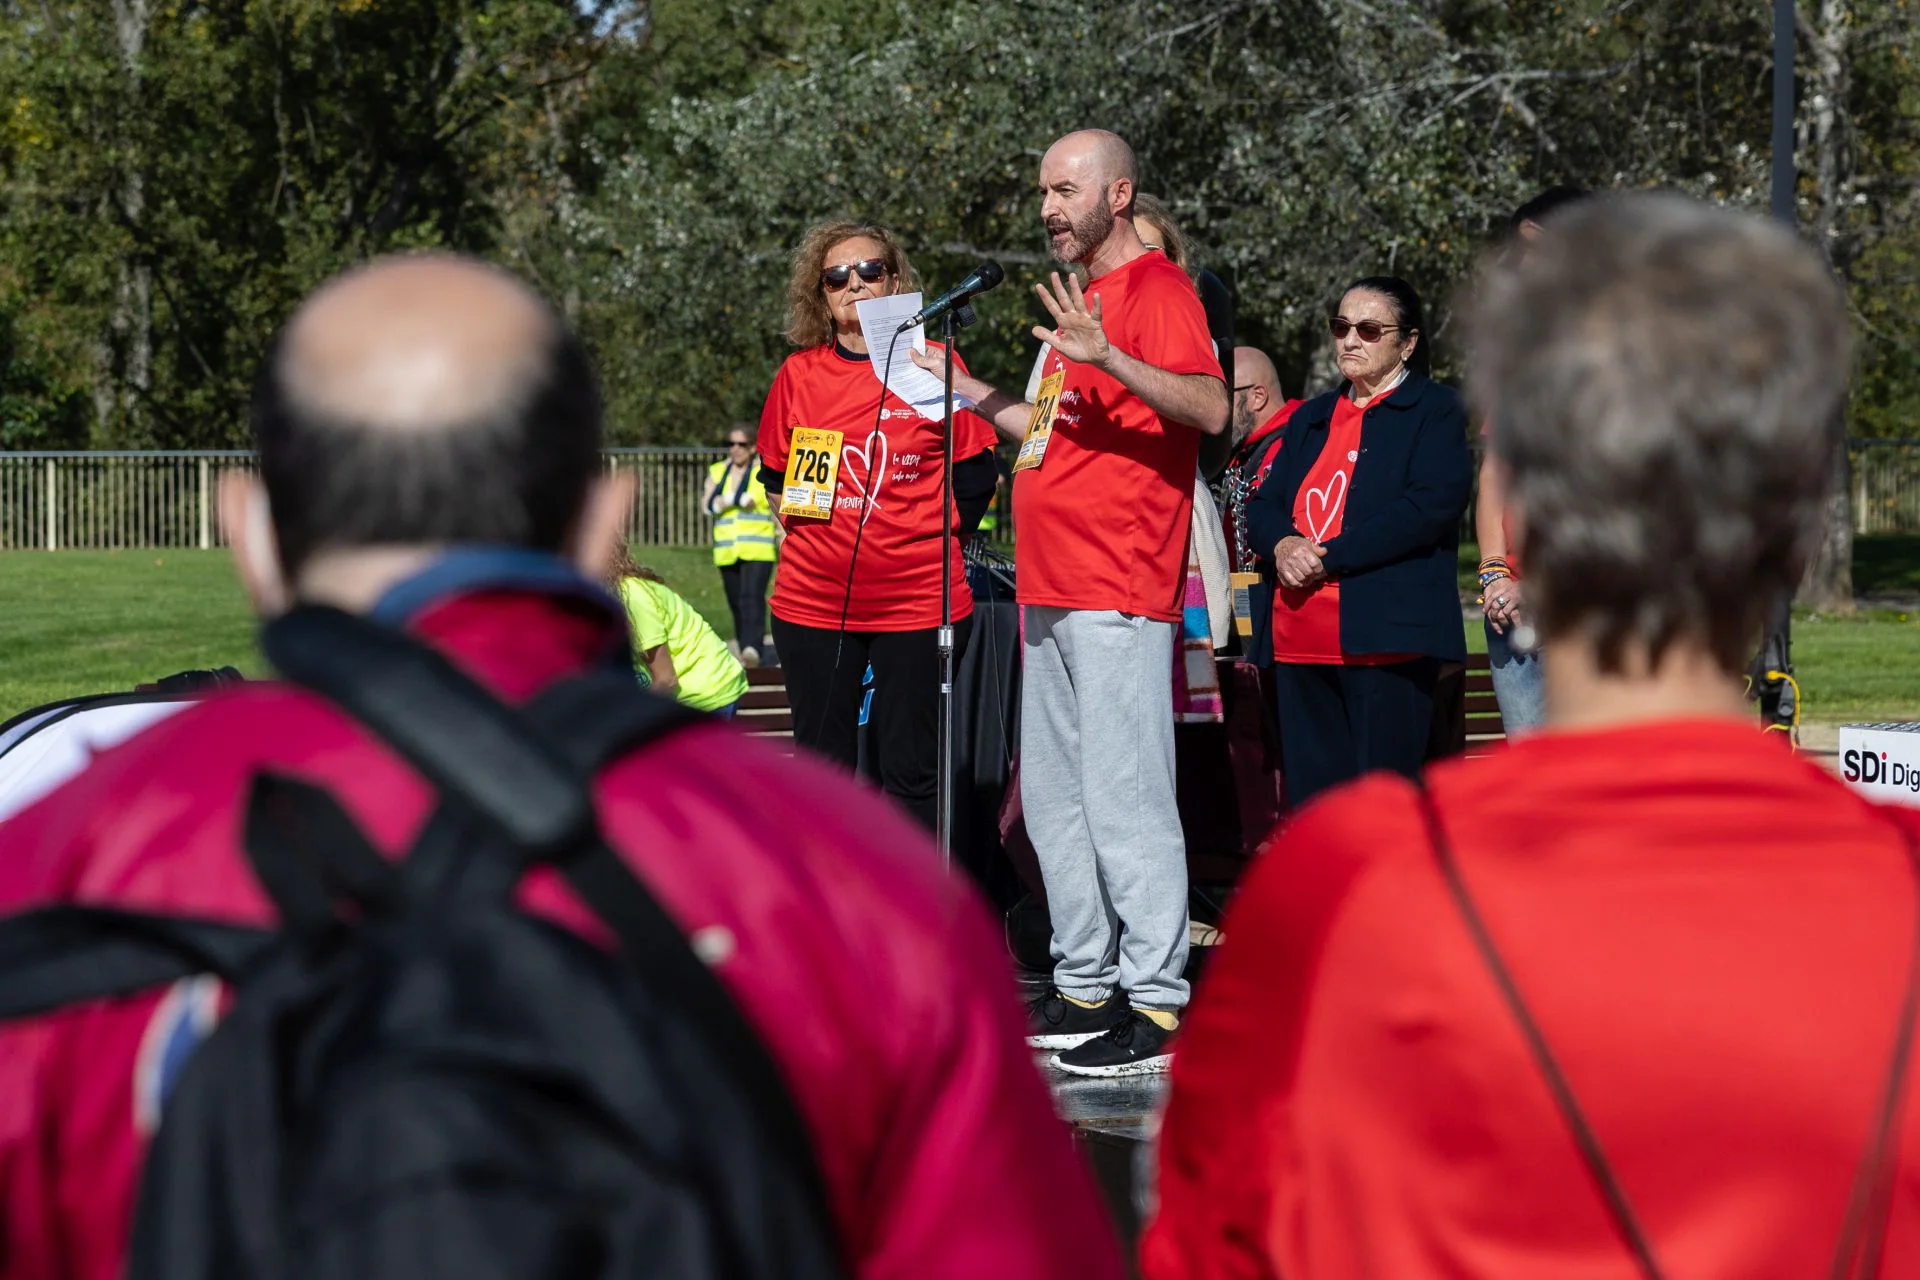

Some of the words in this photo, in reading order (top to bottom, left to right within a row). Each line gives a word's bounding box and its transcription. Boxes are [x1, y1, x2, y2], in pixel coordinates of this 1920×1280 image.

[1028, 394, 1056, 435] 724
[793, 448, 831, 485] 726
[1844, 749, 1887, 784] SDi
[1893, 763, 1920, 792] Dig
